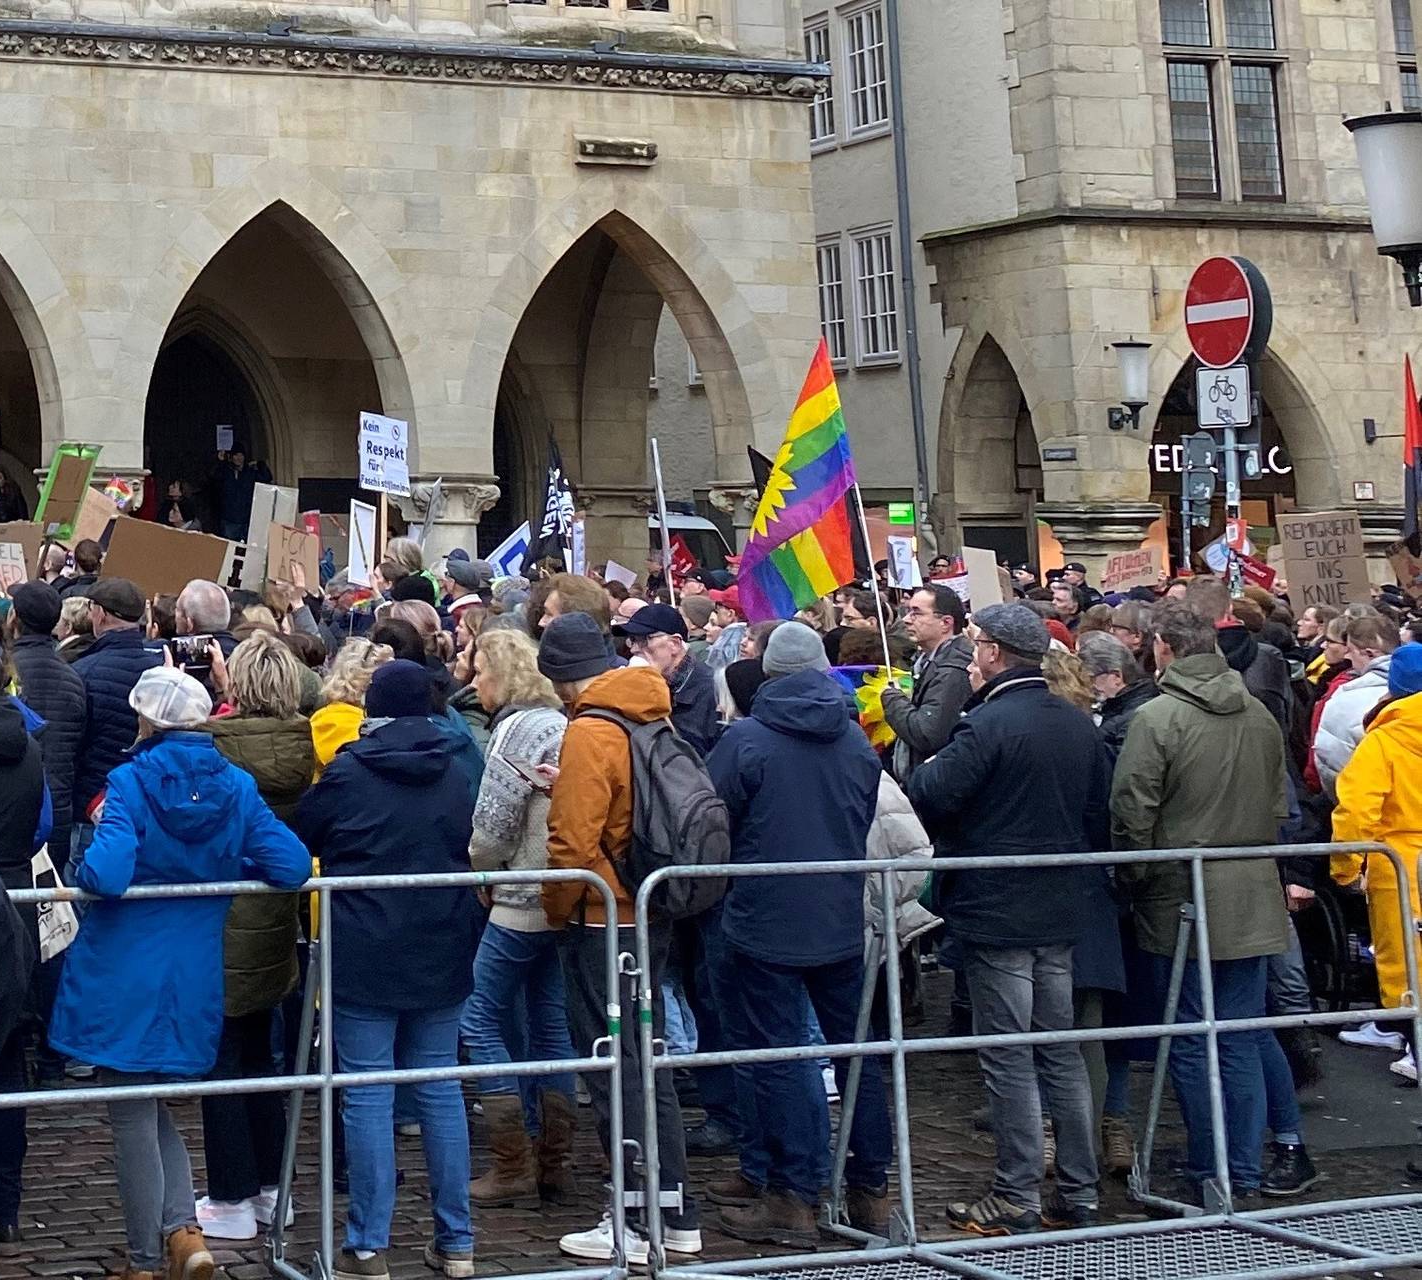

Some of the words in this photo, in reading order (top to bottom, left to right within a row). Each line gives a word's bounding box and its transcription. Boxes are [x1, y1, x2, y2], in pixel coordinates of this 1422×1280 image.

[363, 419, 380, 433] Kein
[366, 440, 405, 461] Respekt
[367, 458, 380, 472] für
[1304, 539, 1347, 558] EUCH
[1316, 560, 1344, 579] INS
[1301, 582, 1350, 605] KNIE
